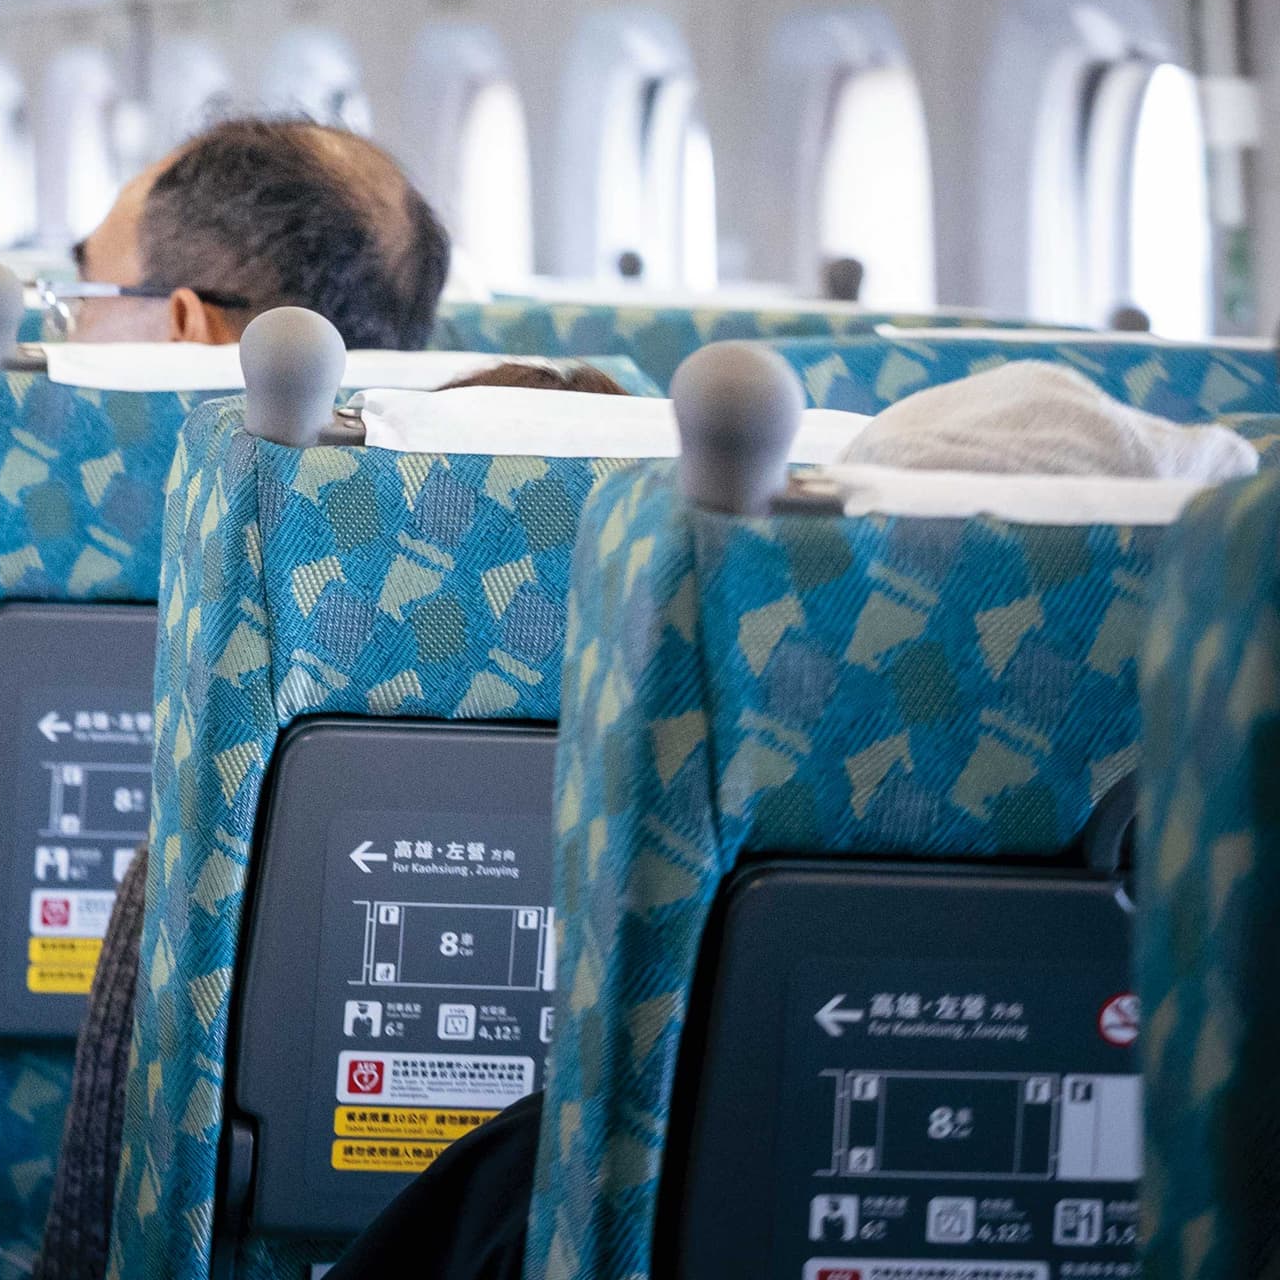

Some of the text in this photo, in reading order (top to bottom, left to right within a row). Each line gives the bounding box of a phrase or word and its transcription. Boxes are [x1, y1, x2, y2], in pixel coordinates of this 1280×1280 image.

[392, 862, 409, 873] For
[476, 864, 519, 879] Zuoying
[440, 931, 458, 957] 8
[928, 1106, 953, 1139] 8
